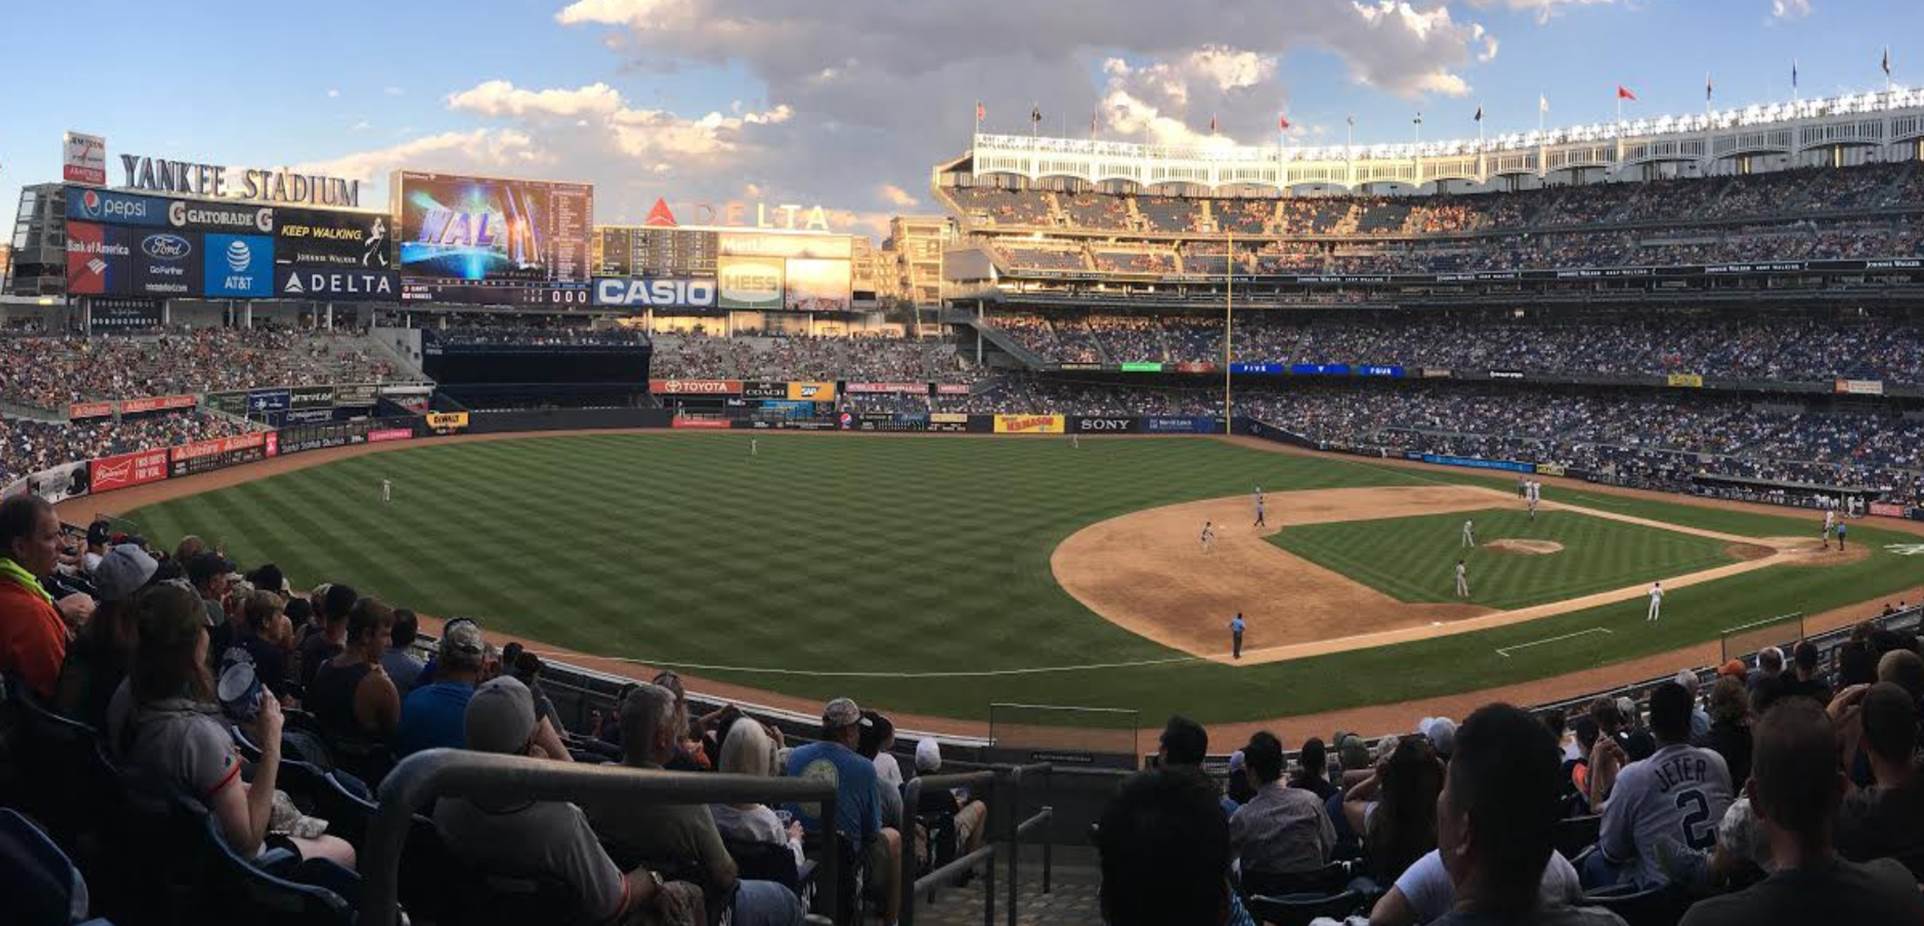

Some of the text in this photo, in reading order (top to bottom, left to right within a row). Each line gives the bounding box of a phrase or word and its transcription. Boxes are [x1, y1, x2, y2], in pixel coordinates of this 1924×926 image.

[120, 154, 359, 207] YANKEE STADIUM
[104, 199, 146, 218] pepsi
[187, 208, 254, 226] GATORADE
[694, 203, 829, 230] DELTA
[281, 225, 309, 237] KEEP
[67, 239, 129, 255] Bank of America
[151, 238, 182, 255] Ford
[225, 276, 253, 290] AT&T
[312, 274, 391, 294] DELTA
[598, 279, 714, 305] CASIO
[724, 274, 777, 292] HESS
[552, 291, 560, 302] 0
[565, 291, 573, 302] 0
[578, 292, 586, 303] 0
[684, 382, 727, 391] TOYOTA
[801, 386, 817, 396] SAP
[1081, 419, 1130, 429] SONY
[1655, 759, 1707, 793] JETER
[1675, 787, 1717, 850] 2
